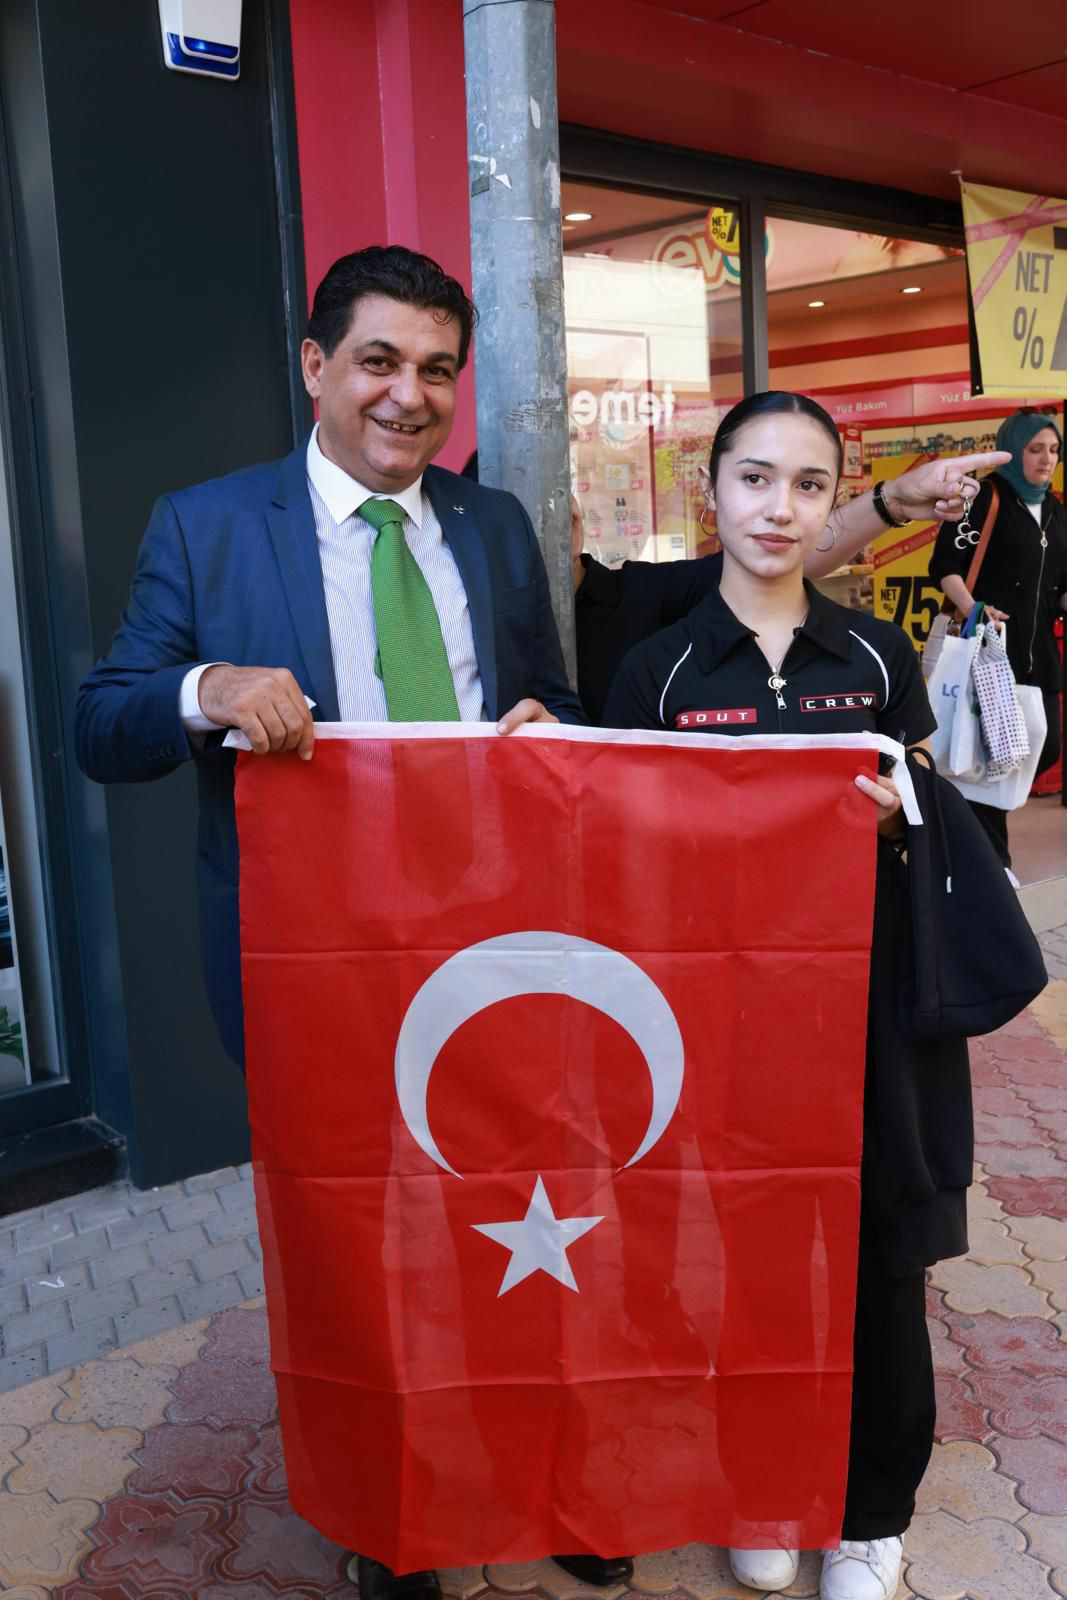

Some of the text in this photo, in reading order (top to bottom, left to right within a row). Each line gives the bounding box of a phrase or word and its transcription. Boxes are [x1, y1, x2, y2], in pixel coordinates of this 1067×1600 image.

[711, 215, 728, 226] NET
[1015, 250, 1054, 293] NET
[1013, 306, 1044, 369] %
[941, 392, 960, 403] Yüz
[835, 400, 887, 413] Yüz Bakım
[881, 589, 896, 601] NET
[886, 576, 939, 642] 75
[805, 695, 873, 709] CREW
[680, 711, 749, 725] SOUT
